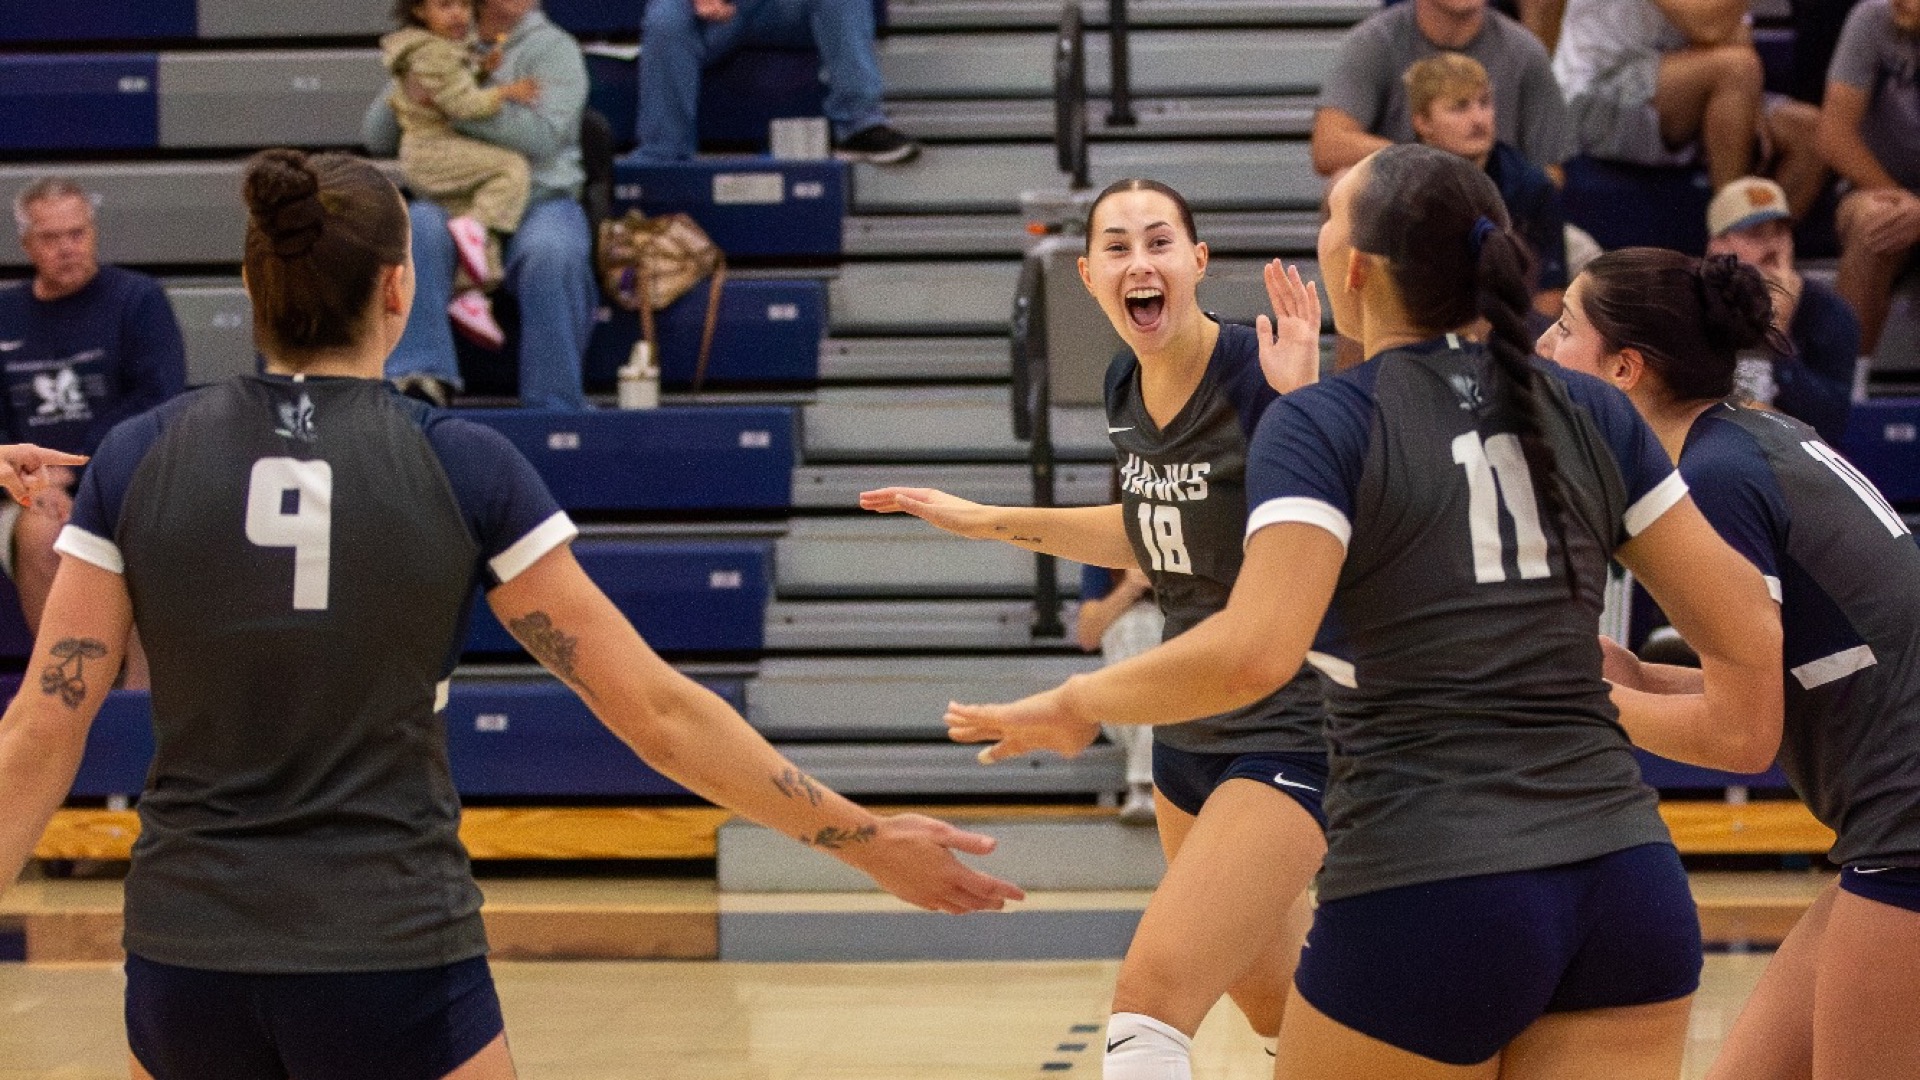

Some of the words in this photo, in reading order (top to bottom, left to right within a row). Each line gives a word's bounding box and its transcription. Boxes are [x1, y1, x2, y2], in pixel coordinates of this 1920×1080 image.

[246, 457, 333, 610] 9
[1137, 502, 1194, 576] 18
[1452, 430, 1551, 583] 11
